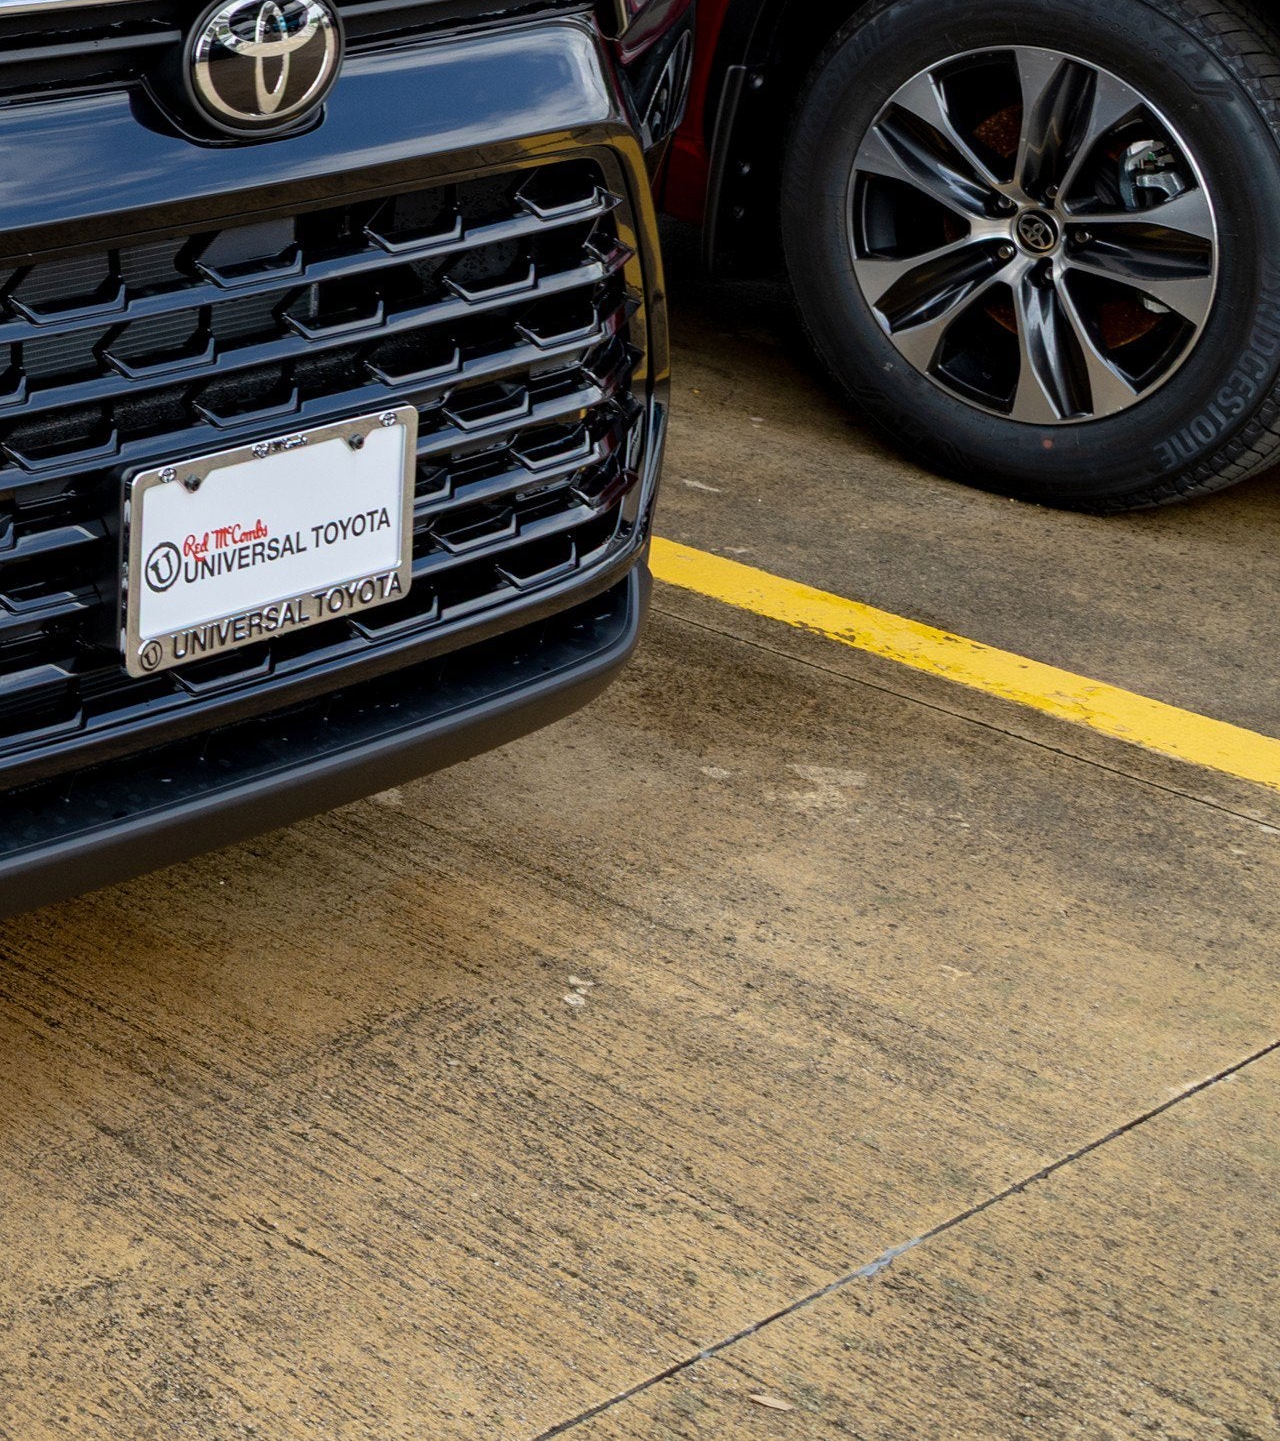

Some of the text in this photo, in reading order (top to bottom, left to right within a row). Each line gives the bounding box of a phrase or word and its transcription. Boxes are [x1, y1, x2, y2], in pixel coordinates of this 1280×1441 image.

[183, 518, 268, 562] Red McCombs
[184, 507, 391, 584] UNIVERSAL TOYOTA
[171, 571, 403, 659] UNIVERSAL TOYOTA
